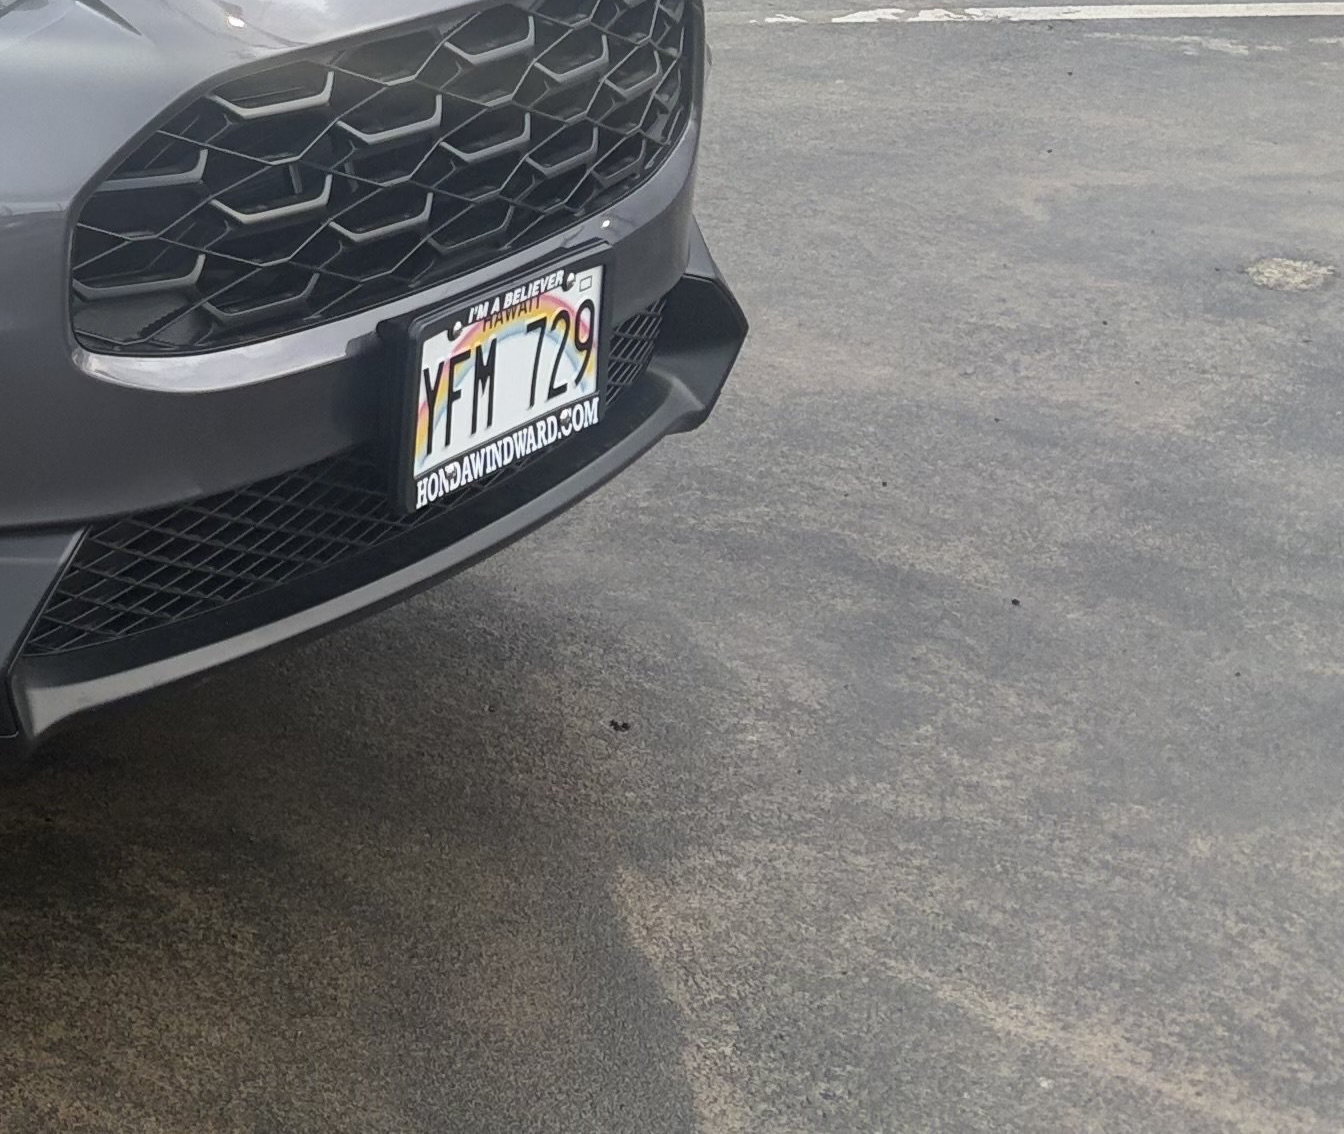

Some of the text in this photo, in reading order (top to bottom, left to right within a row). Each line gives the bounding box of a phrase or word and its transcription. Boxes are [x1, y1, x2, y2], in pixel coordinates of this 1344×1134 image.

[468, 269, 565, 324] I'M A BELIEVER
[423, 299, 596, 456] YFM 729
[415, 397, 599, 510] HONDAWINDWARD.COM
